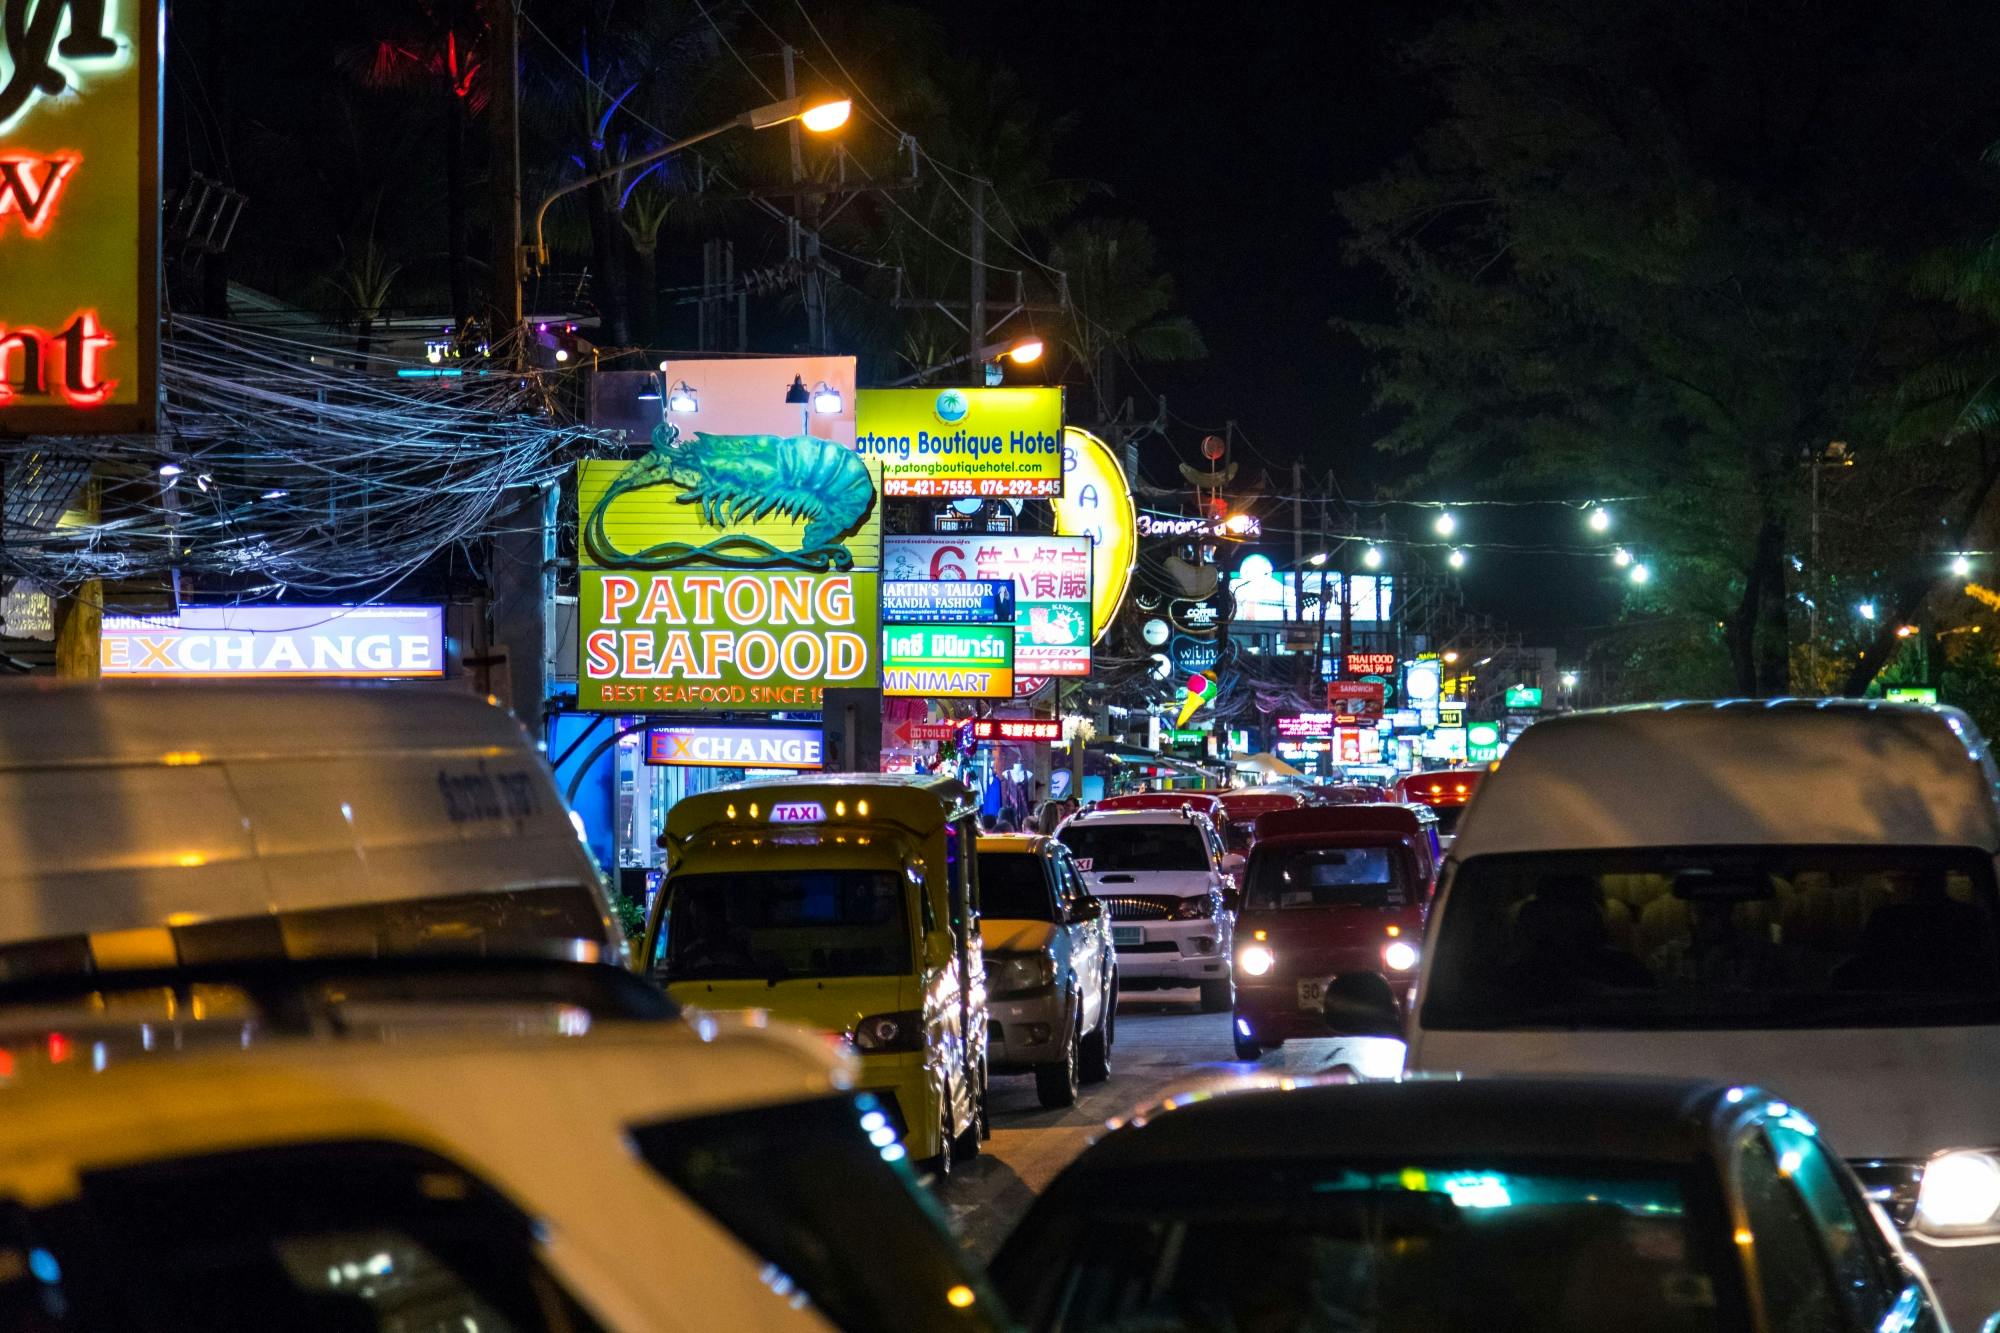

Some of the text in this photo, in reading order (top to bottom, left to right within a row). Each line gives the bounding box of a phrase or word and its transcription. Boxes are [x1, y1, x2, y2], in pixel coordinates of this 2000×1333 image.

[918, 430, 1003, 461] Boutique
[1009, 431, 1061, 455] Hotel
[885, 481, 1061, 497] 095-421-7555, 076-292-545
[944, 583, 993, 597] TAILOR
[600, 575, 855, 625] PATONG
[883, 598, 982, 609] SKANDIA FASHION
[102, 635, 431, 671] EXCHANGE
[586, 629, 867, 681] SEAFOOD
[1347, 654, 1394, 664] THAI FOOD
[1040, 659, 1060, 671] 24
[883, 671, 990, 692] MINIMART
[1340, 684, 1374, 693] SANDWICH
[602, 686, 646, 702] BEST
[652, 686, 745, 704] SEAFOOD
[751, 686, 804, 704] SINCE
[922, 729, 952, 739] TOILET
[651, 736, 821, 762] EXCHANGE
[777, 807, 817, 820] TAXI
